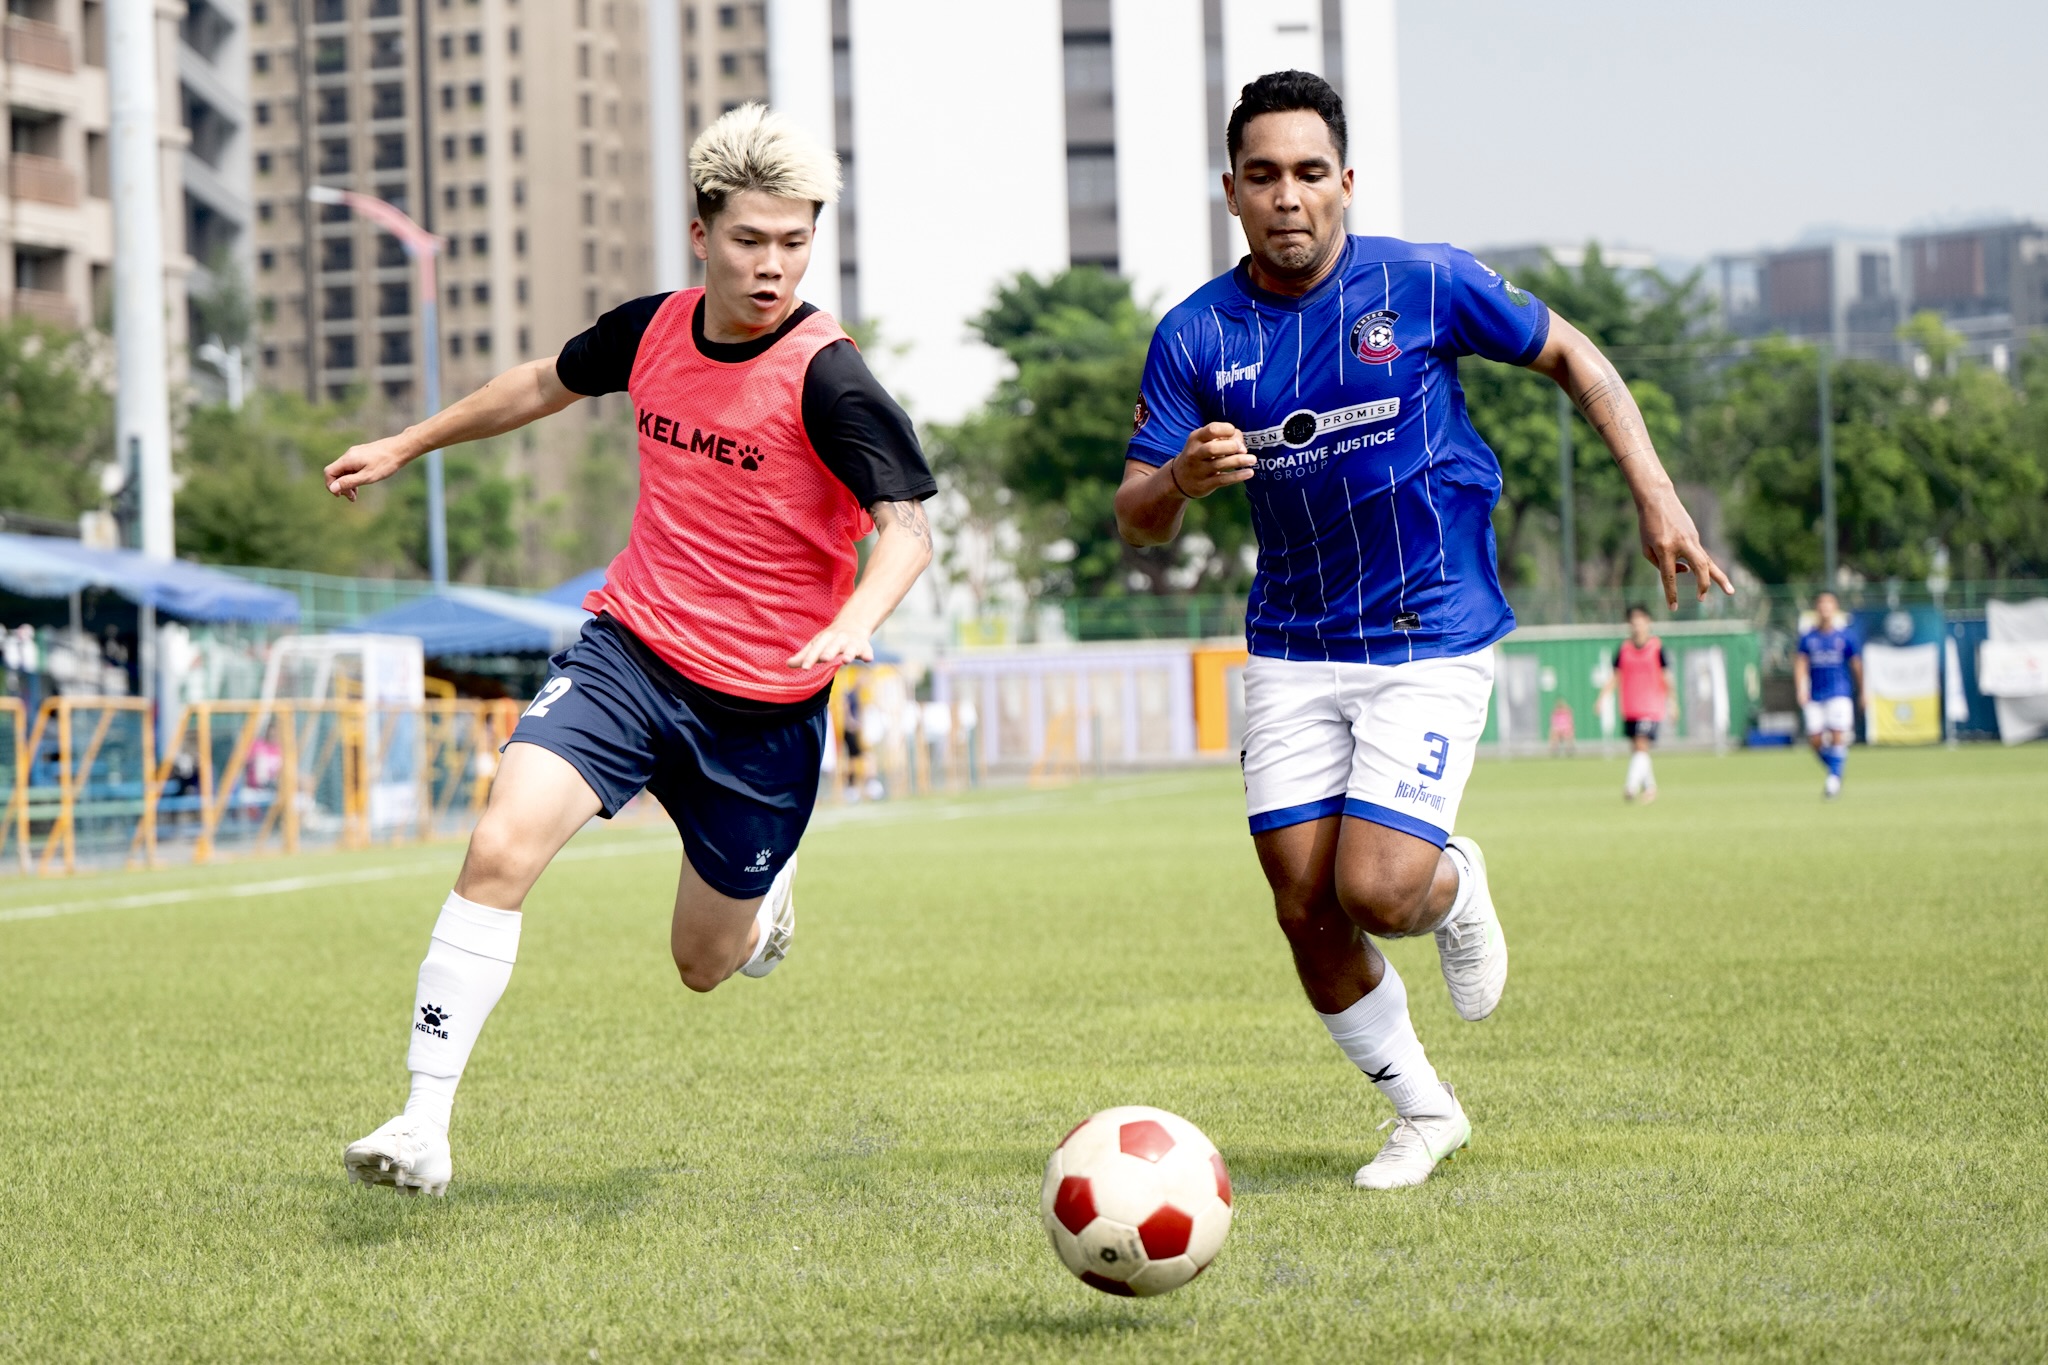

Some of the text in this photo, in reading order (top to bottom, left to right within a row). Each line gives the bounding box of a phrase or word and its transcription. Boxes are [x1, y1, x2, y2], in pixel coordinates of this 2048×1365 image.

[1353, 311, 1384, 335] CENTRO
[1323, 403, 1397, 427] PROMISE
[638, 408, 737, 466] KELME
[1333, 428, 1396, 456] JUSTICE
[1273, 459, 1329, 481] GROUP
[1416, 731, 1450, 781] 3
[743, 864, 770, 873] KELME
[415, 1021, 449, 1040] KELME
